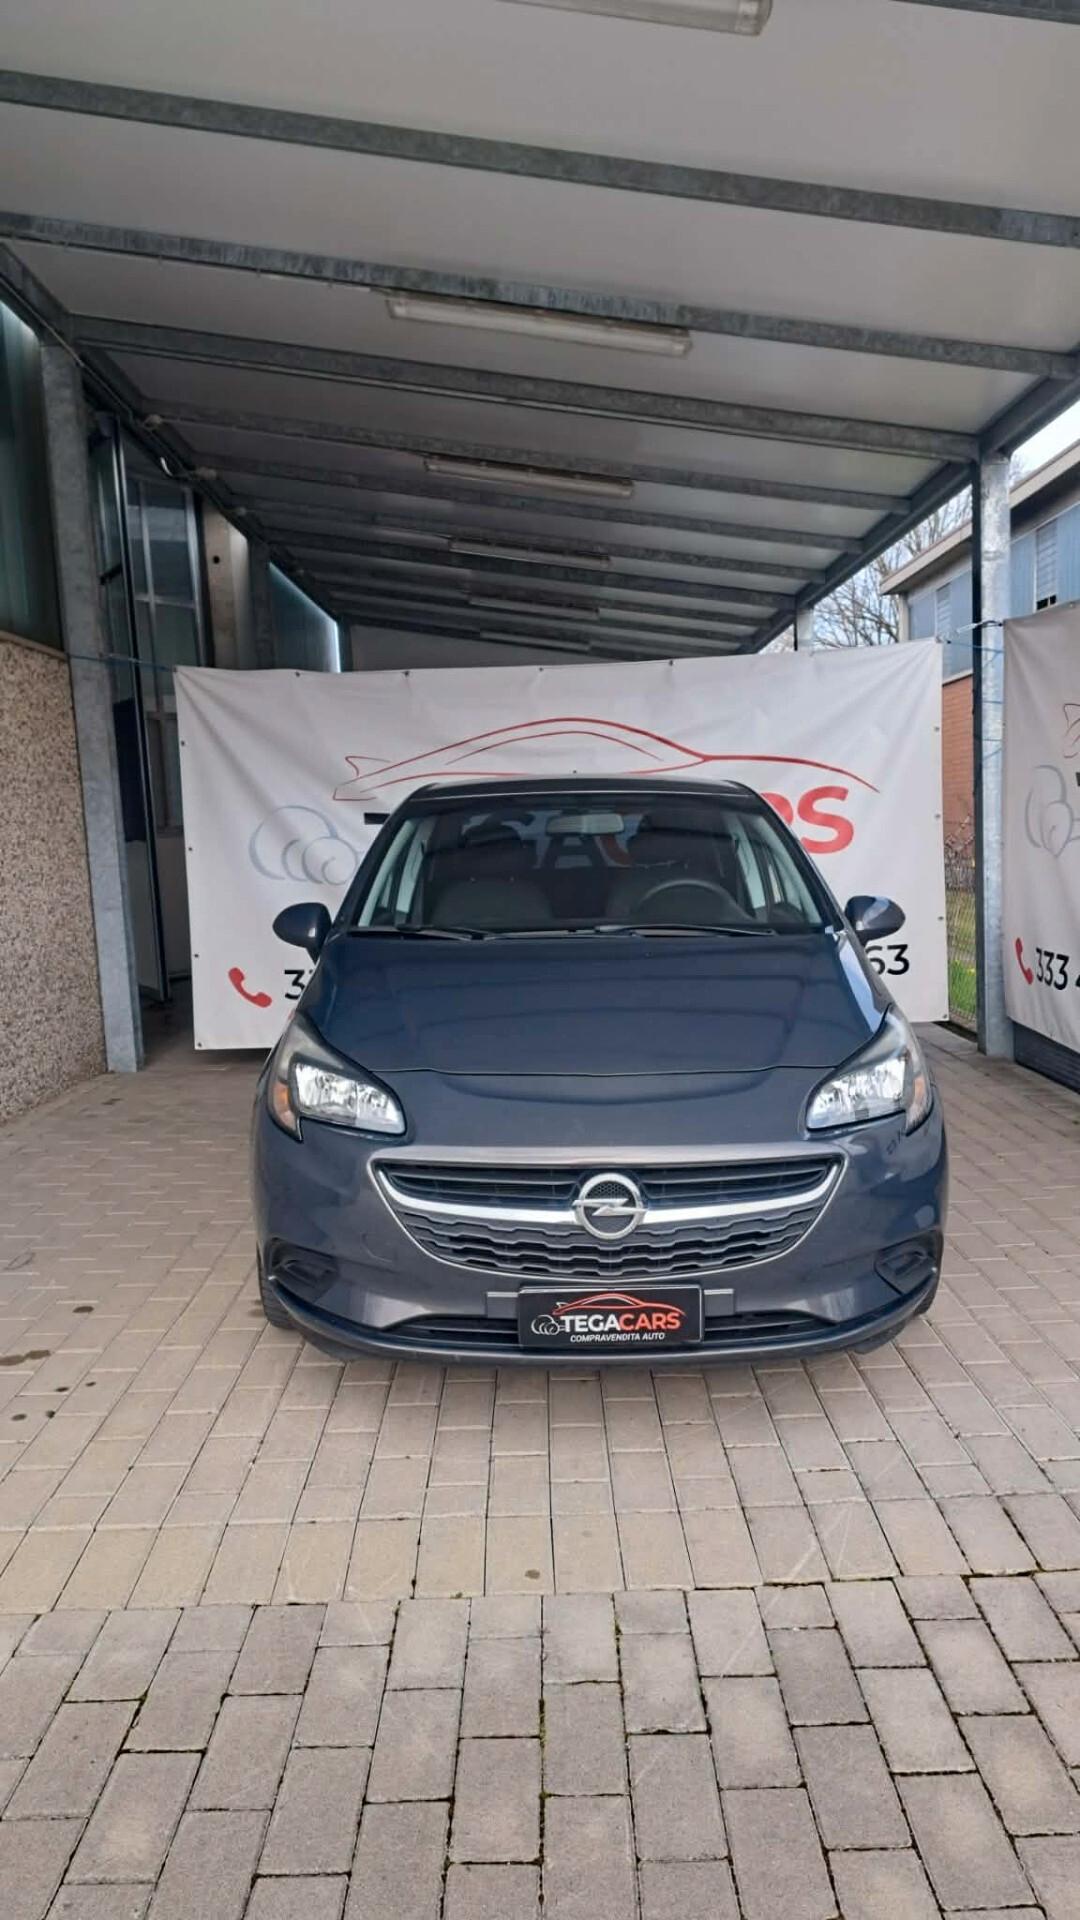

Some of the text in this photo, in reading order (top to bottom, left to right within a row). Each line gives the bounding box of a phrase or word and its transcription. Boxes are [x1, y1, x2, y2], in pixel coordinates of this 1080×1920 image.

[1036, 947, 1069, 990] 333
[284, 969, 313, 1000] 3
[560, 1312, 681, 1333] TEGACARS
[570, 1332, 665, 1343] COMPRAVENDITA AUTO
